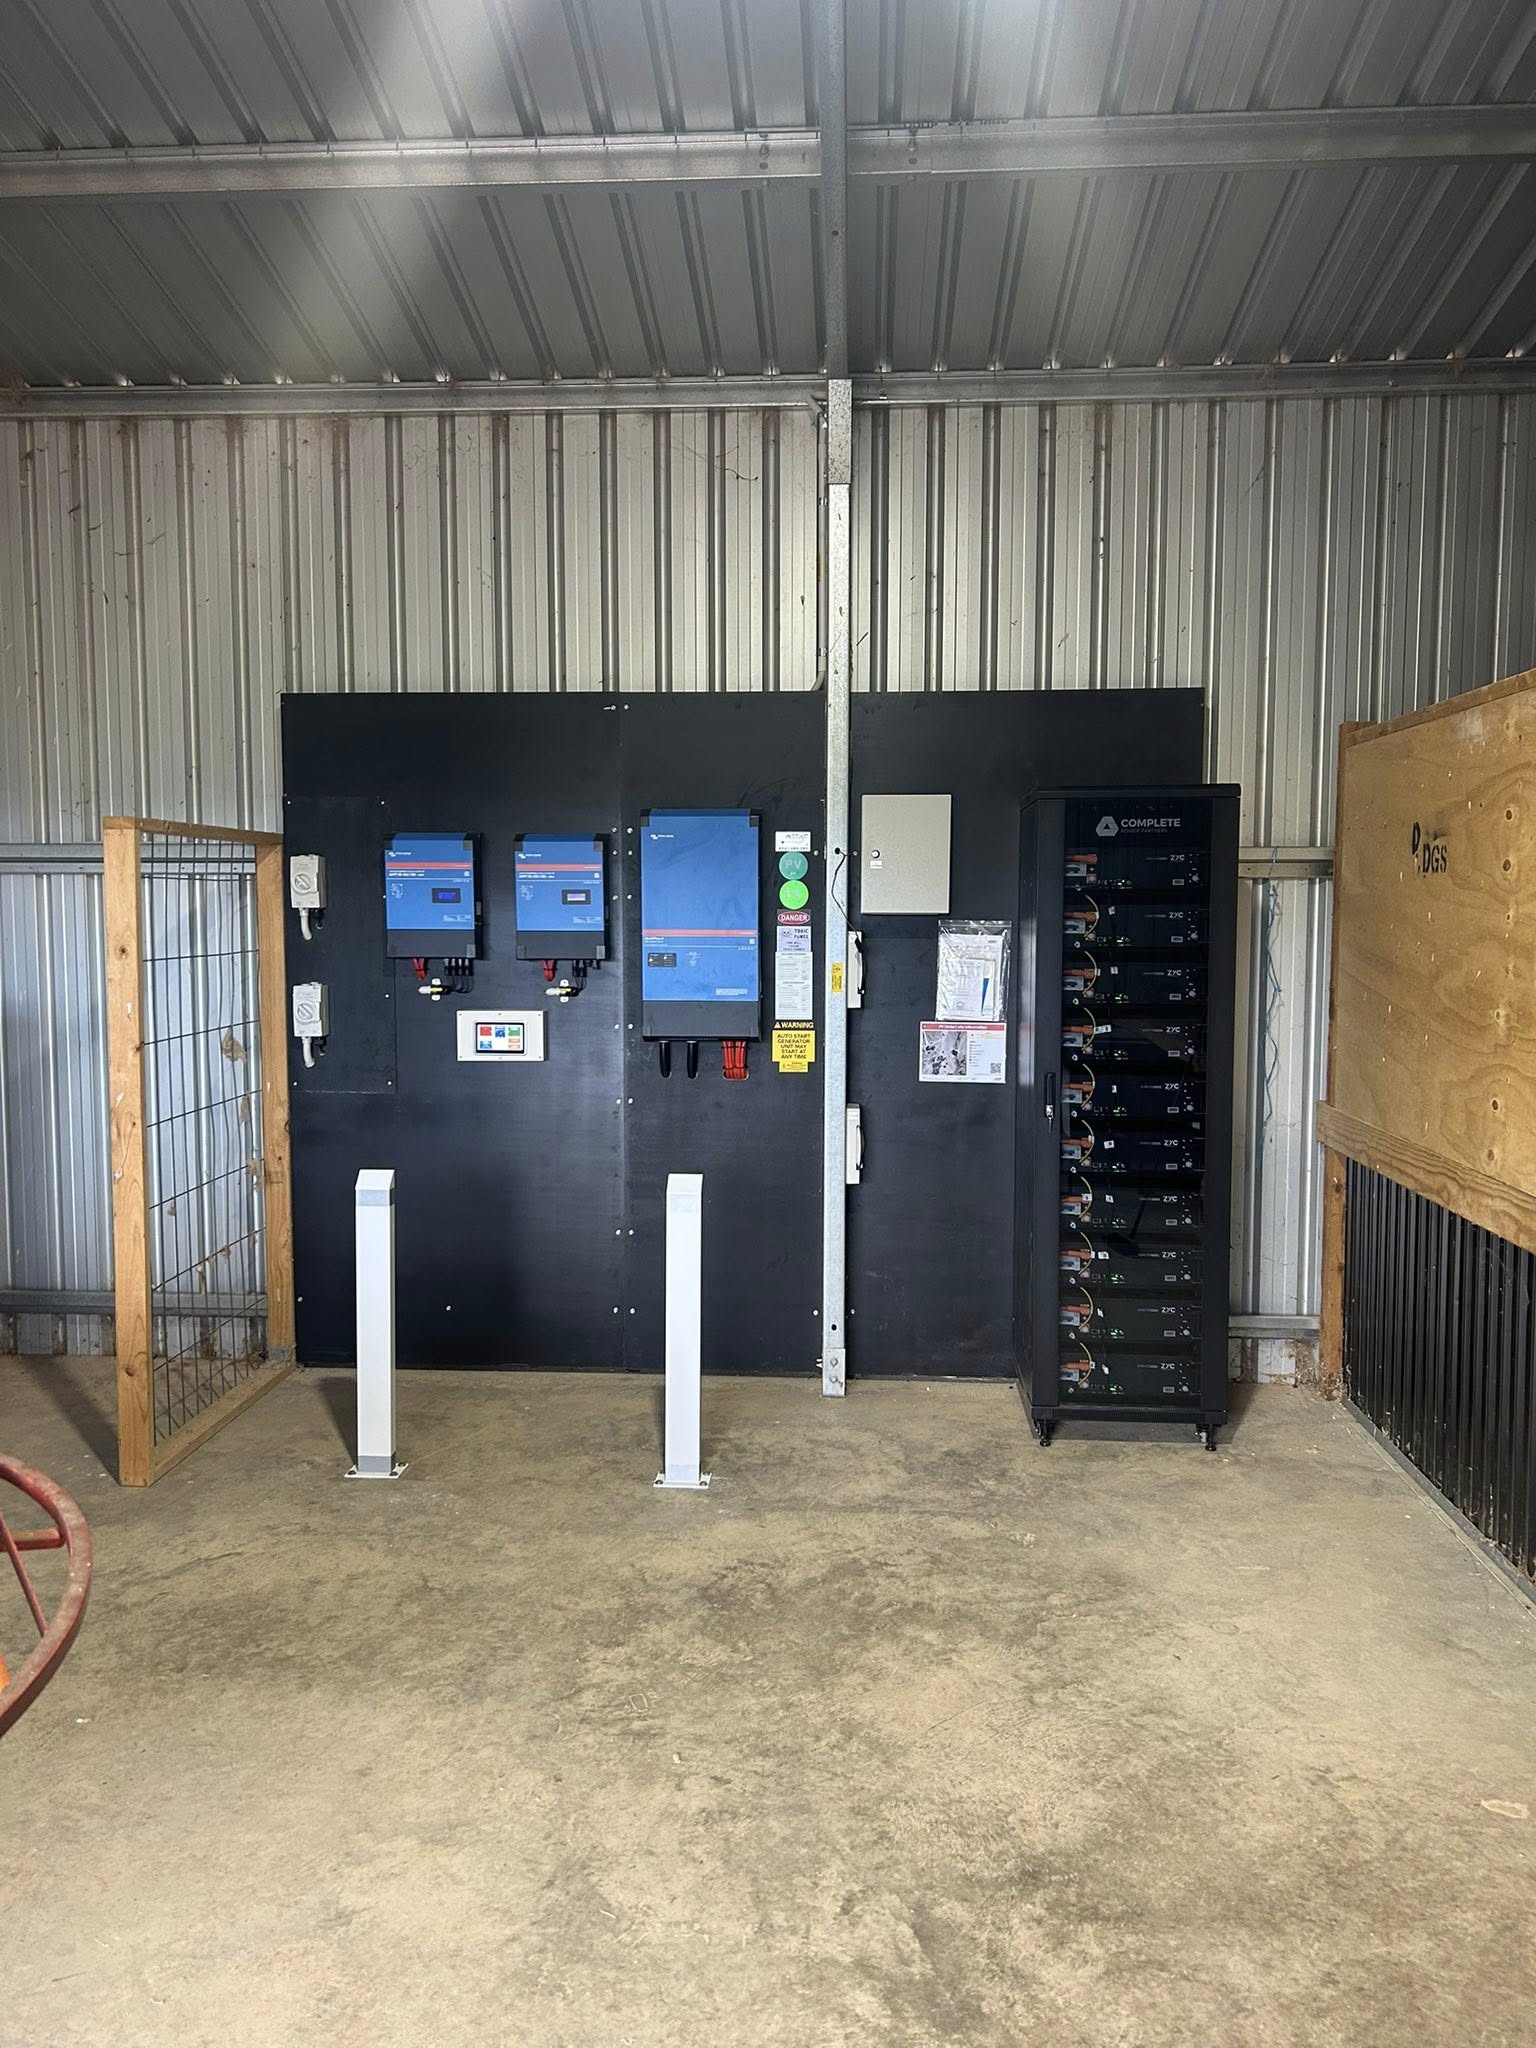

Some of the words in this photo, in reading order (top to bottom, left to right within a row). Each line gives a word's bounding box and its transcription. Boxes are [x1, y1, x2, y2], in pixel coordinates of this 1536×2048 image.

[1121, 818, 1181, 828] COMPLETE
[785, 859, 802, 869] PV
[1169, 911, 1184, 919] ZYC
[1160, 1362, 1175, 1370] ZYC
